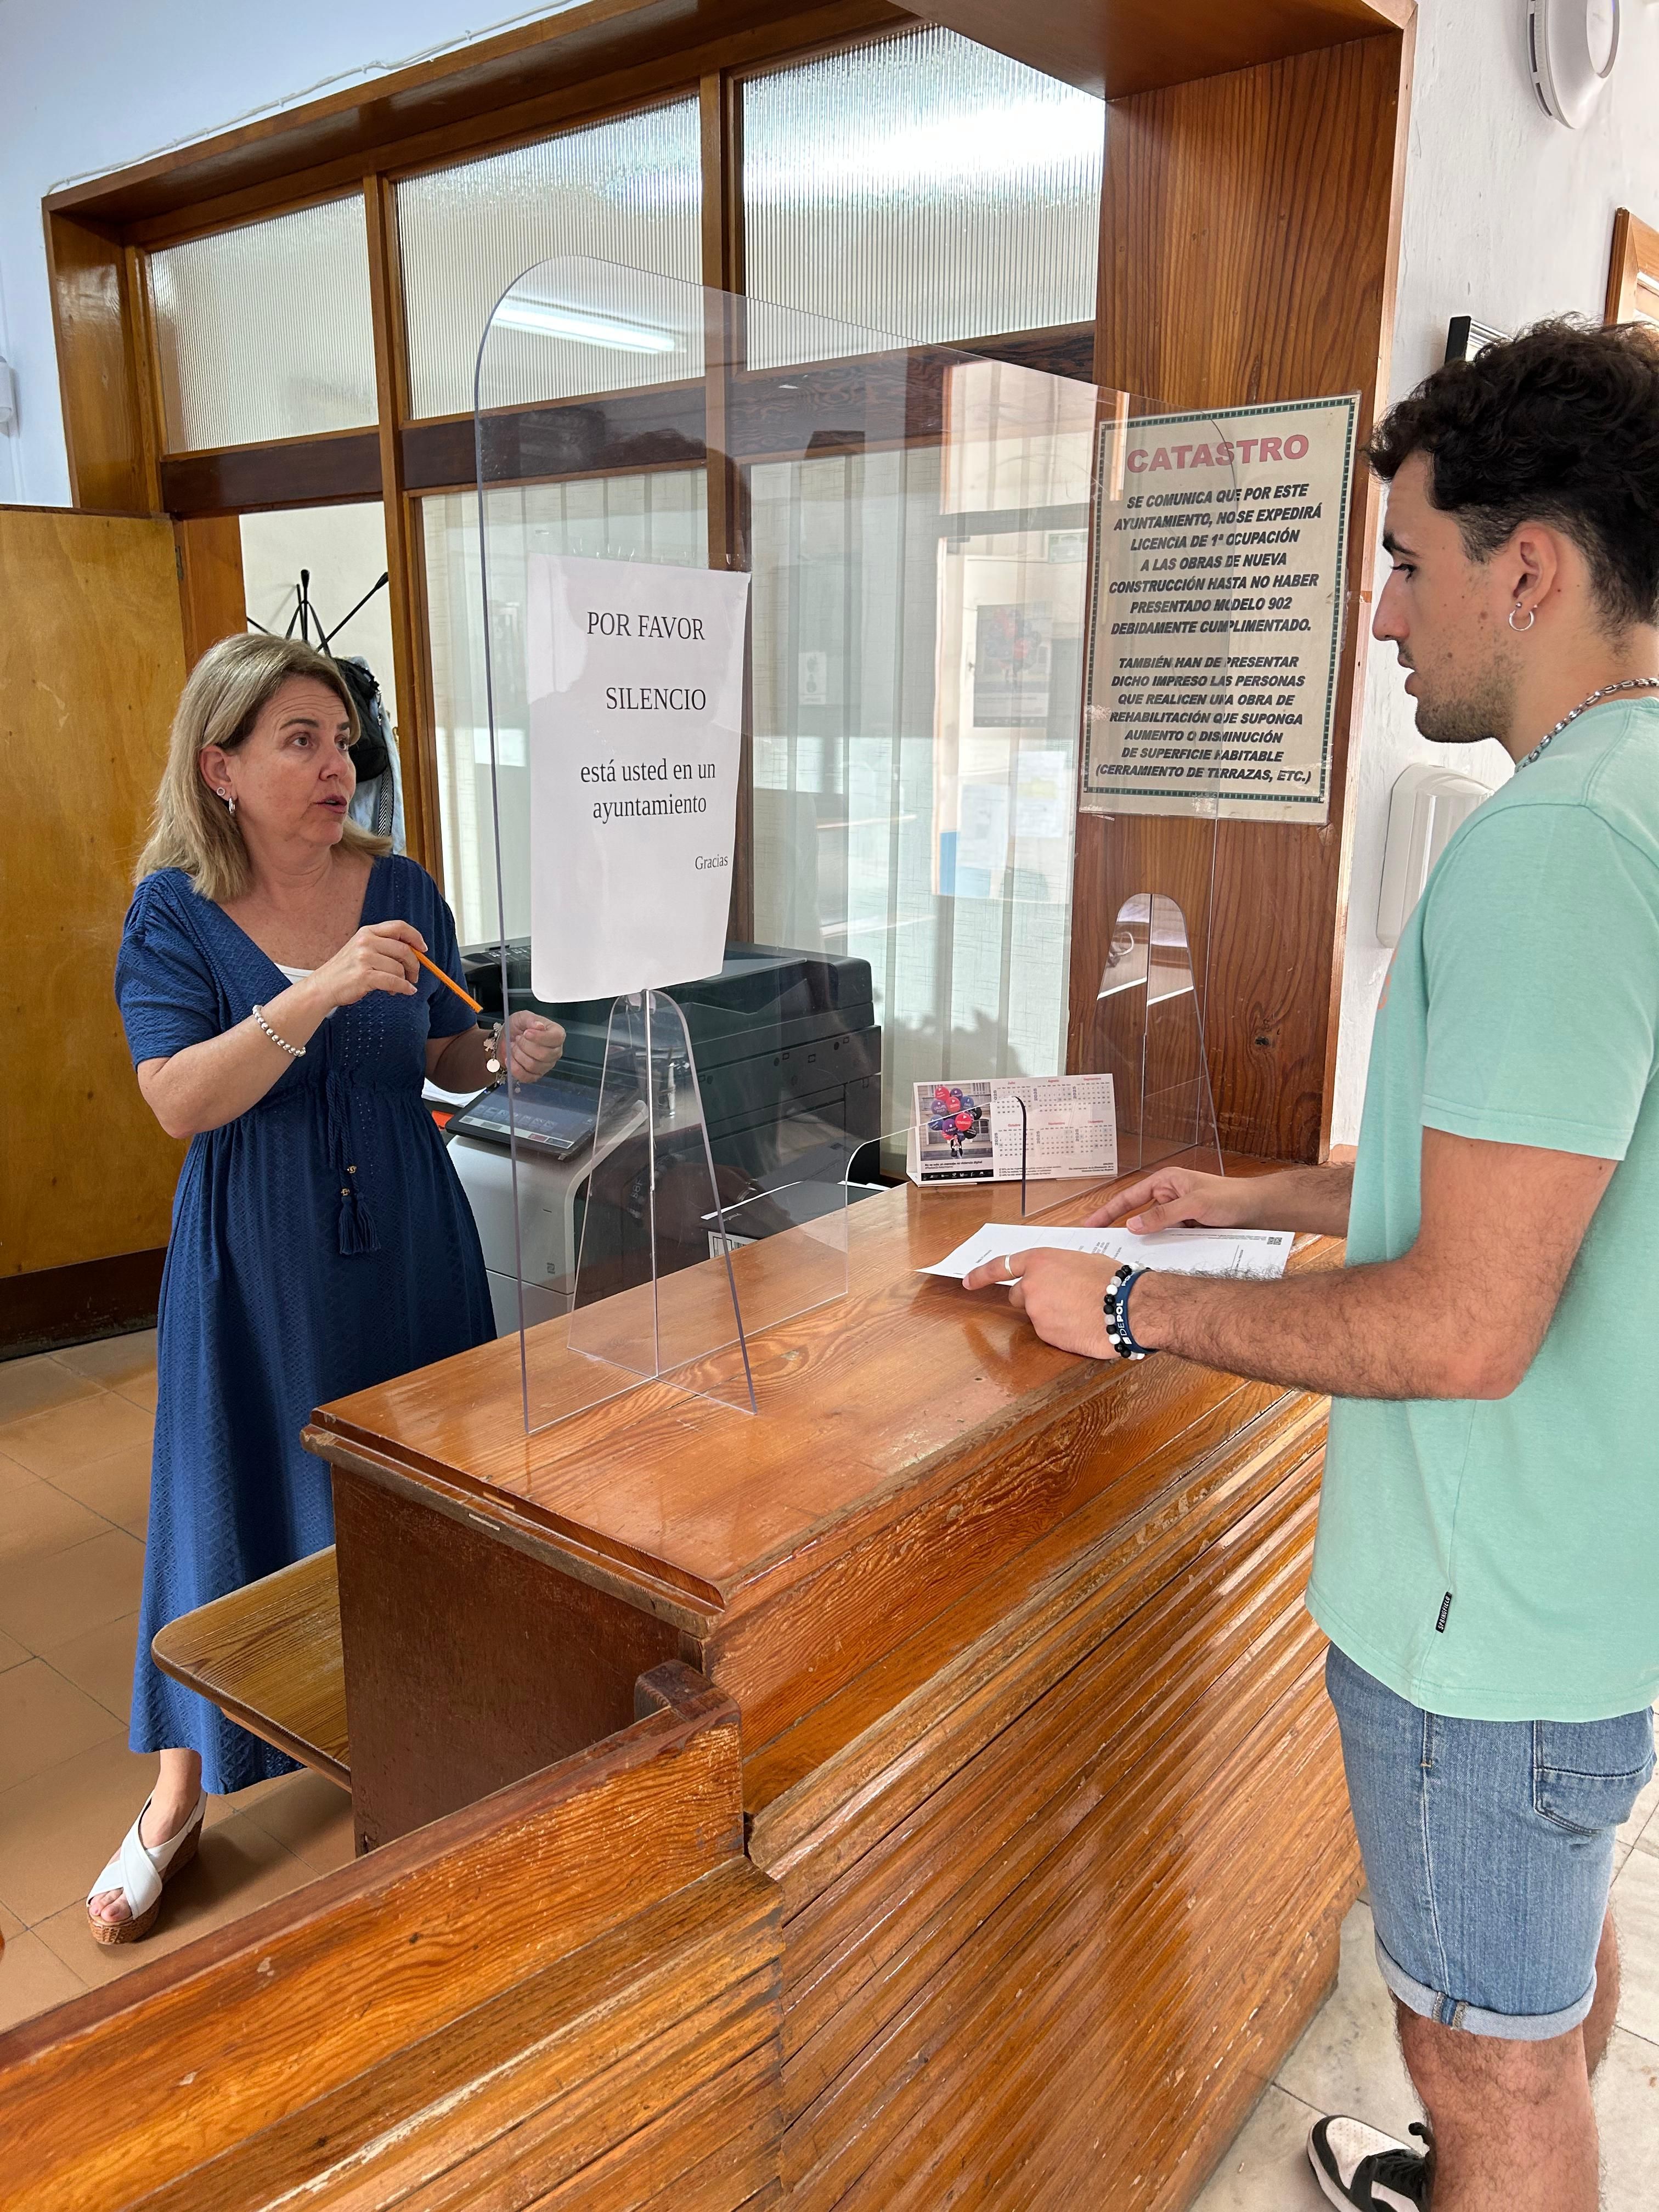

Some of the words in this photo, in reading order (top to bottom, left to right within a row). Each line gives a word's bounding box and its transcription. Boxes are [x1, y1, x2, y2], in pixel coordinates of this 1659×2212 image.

[1127, 435, 1309, 473] CATASTRO
[1127, 496, 1143, 509] SE
[1146, 490, 1212, 507] COMUNICA
[1216, 489, 1242, 502] QUE
[1244, 487, 1271, 500] POR
[1273, 484, 1309, 498] ESTE
[1114, 514, 1213, 531] AYUNTAMIENTO,
[1216, 512, 1235, 524] NO
[1237, 510, 1254, 523] SE
[1256, 503, 1322, 522] EXPEDIRÁ
[1130, 534, 1187, 551] LICENCIA
[1190, 534, 1208, 548] DE
[1211, 533, 1223, 546] 1ª
[1226, 529, 1300, 545] OCUPACIÓN
[1140, 559, 1149, 571] A
[1152, 557, 1176, 571] LAS
[1179, 555, 1222, 570] OBRAS
[1224, 554, 1239, 567] DE
[1243, 552, 1287, 567] NUEVA
[1109, 575, 1206, 594] CONSTRUCCIÓN
[1207, 576, 1246, 590] HASTA
[1250, 575, 1271, 589] NO
[1273, 574, 1319, 587] HABER
[1130, 599, 1211, 614] PRESENTADO
[1213, 597, 1265, 612] MODELO
[1268, 596, 1293, 610] 902
[587, 612, 631, 636] POR
[638, 614, 706, 641] FAVOR
[1111, 620, 1198, 635] DEBIDAMENTE
[1200, 619, 1311, 633] CUMPLIMENTADO.
[1119, 655, 1171, 668] TAMBIÉN
[1174, 657, 1202, 668] HAN
[1204, 657, 1222, 668] DE
[1224, 657, 1299, 668] PRESENTAR
[1111, 675, 1149, 687] DICHO
[1152, 675, 1207, 687] IMPRESO
[1210, 676, 1232, 687] LAS
[1234, 675, 1305, 687] PERSONAS
[606, 687, 707, 711] SILENCIO
[1118, 693, 1144, 706] QUE
[1146, 693, 1207, 705] REALICEN
[1210, 694, 1233, 706] UNA
[1237, 695, 1273, 706] OBRA
[1276, 695, 1295, 706] DE
[1110, 710, 1211, 724] REHABILITACIÓN
[1213, 713, 1238, 725] QUE
[1240, 713, 1303, 725] SUPONGA
[1125, 730, 1184, 742] AUMENTO
[1187, 731, 1197, 742] O
[1199, 729, 1283, 743] DISMINUCIÓN
[1121, 747, 1138, 758] DE
[1140, 748, 1211, 760] SUPERFICIE
[580, 759, 617, 783] está
[622, 758, 667, 782] usted
[673, 763, 692, 780] en
[698, 761, 716, 779] un
[1096, 764, 1184, 777] (CERRAMIENTO
[1187, 767, 1203, 778] DE
[1277, 771, 1312, 783] ETC.)
[592, 794, 707, 824] ayuntamiento
[695, 855, 728, 870] Gracias
[1116, 1299, 1127, 1336] DEPOL
[1437, 1595, 1451, 1630] SPRINGFIELD
